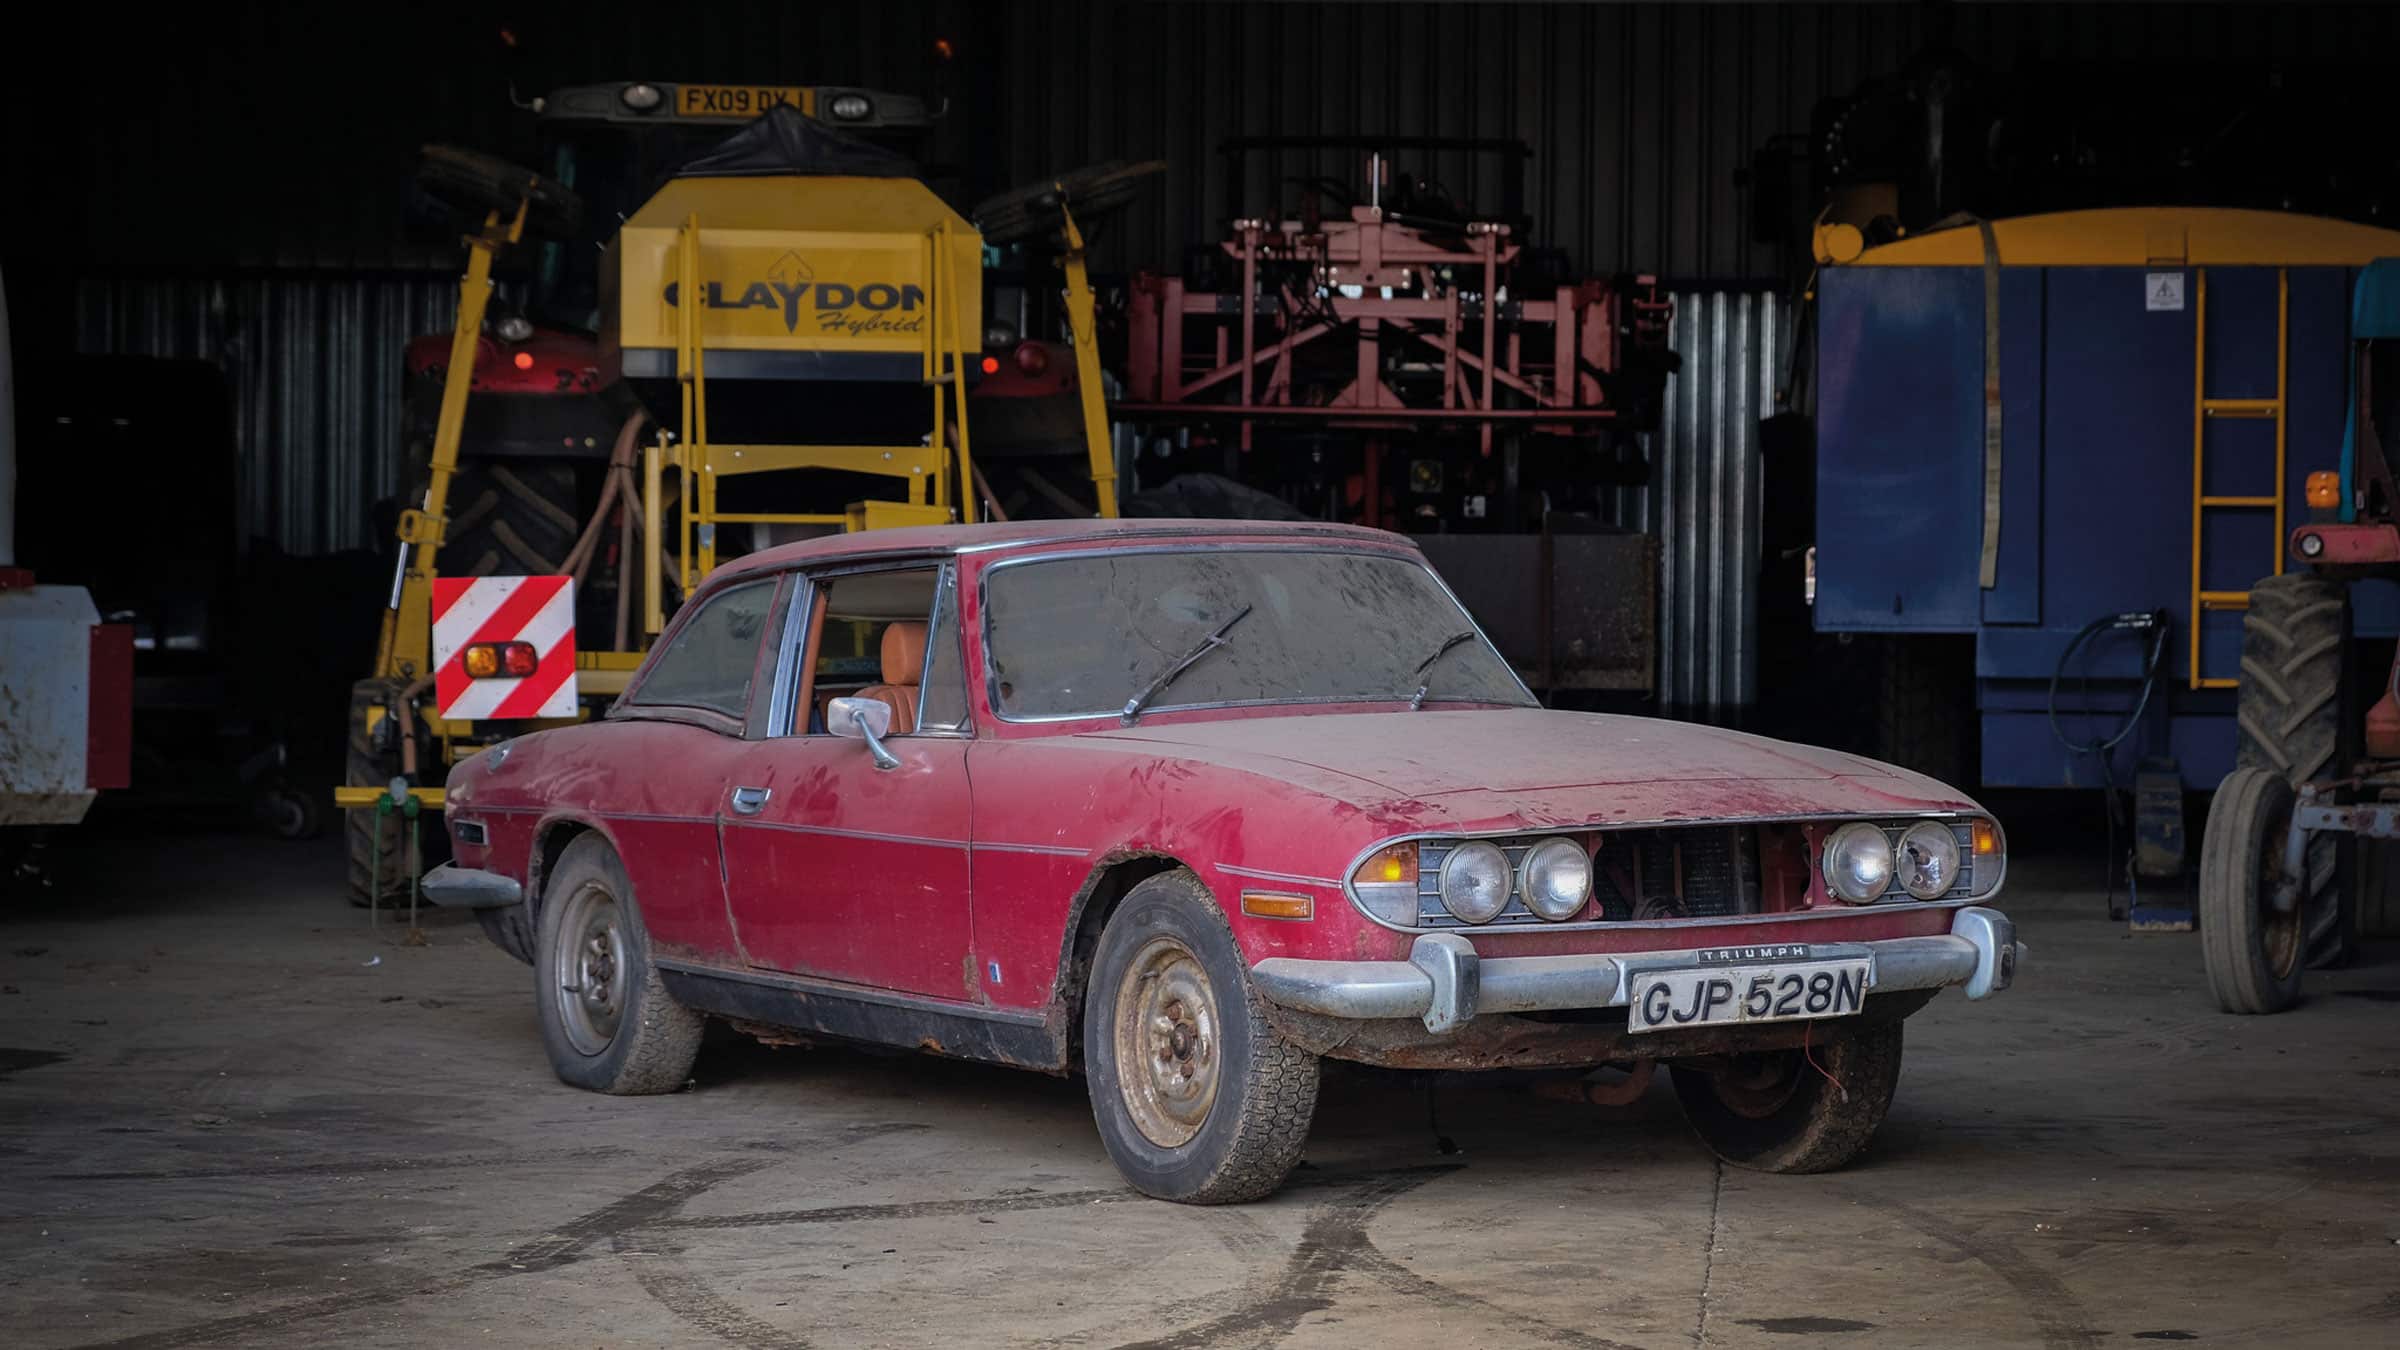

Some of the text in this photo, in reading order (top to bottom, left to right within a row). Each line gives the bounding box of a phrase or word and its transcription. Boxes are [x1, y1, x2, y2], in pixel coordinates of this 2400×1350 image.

[687, 88, 750, 112] FX09
[815, 311, 925, 336] Hybrid
[1703, 946, 1805, 961] TRIUMPH
[1642, 967, 1866, 1025] GJP 528N
